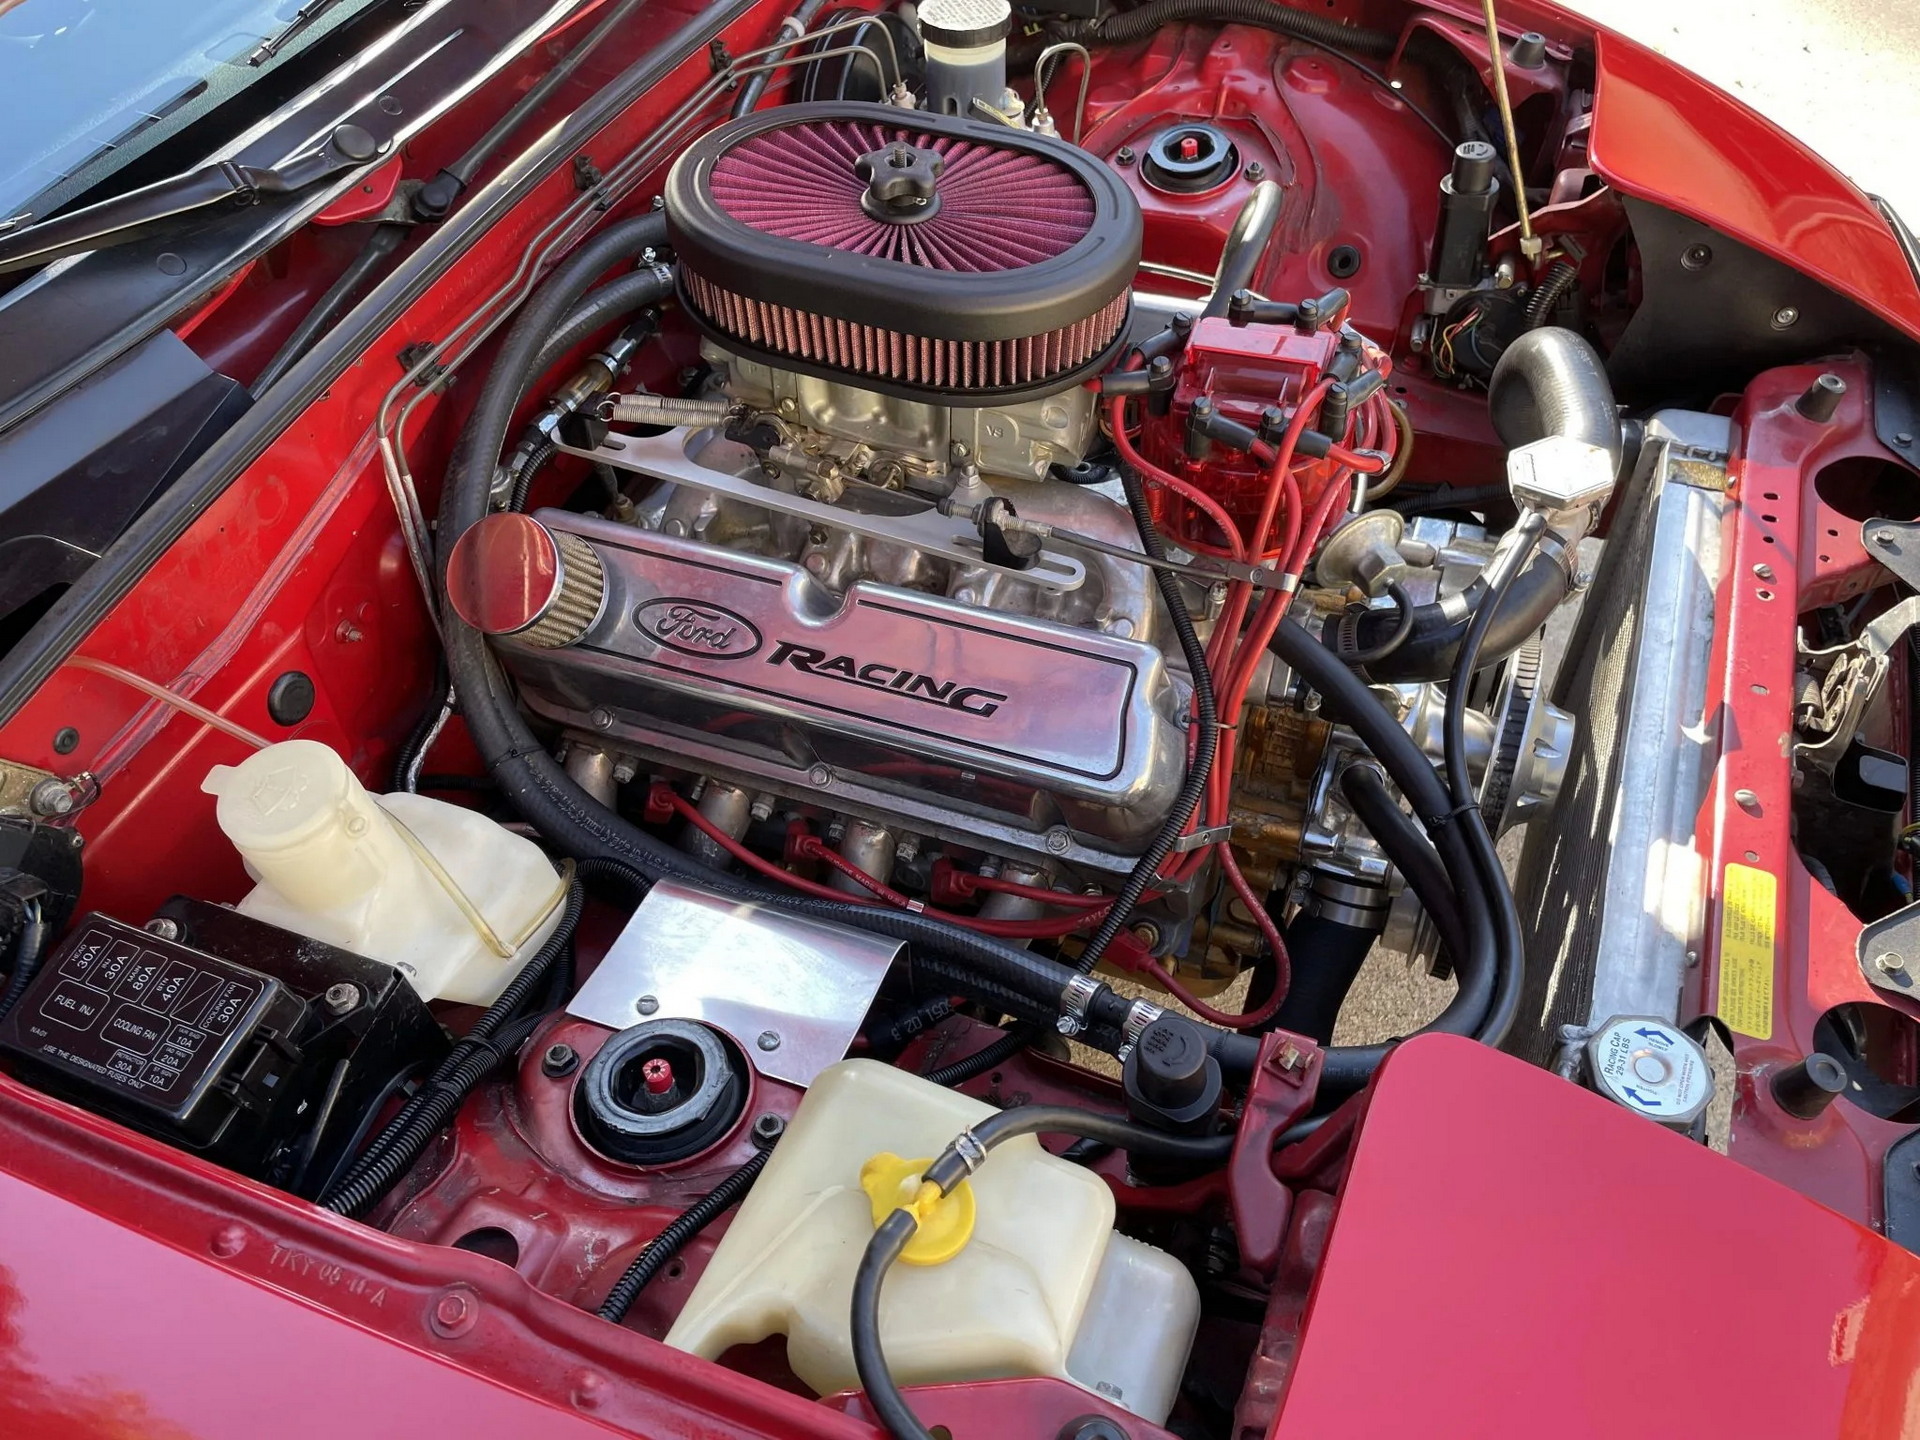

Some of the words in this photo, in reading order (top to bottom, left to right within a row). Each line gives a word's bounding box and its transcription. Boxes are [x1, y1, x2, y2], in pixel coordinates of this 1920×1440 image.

[655, 605, 737, 650] Ford
[765, 640, 1008, 718] RACING
[71, 944, 87, 962] HEAD
[77, 945, 101, 969] 30A
[101, 958, 111, 969] INJ
[104, 955, 128, 980] 30A
[127, 965, 142, 982] MAIN
[132, 965, 156, 990] 80A
[156, 977, 169, 991] BTN
[162, 976, 185, 1001] 40A
[54, 994, 76, 1010] FUEL
[78, 1004, 95, 1016] INJ
[202, 999, 226, 1028] COOLING
[224, 984, 237, 998] FAN
[218, 998, 242, 1023] 30A
[113, 1018, 143, 1036] COOLING
[142, 1029, 158, 1041] FAN
[1610, 1031, 1621, 1047] CAP
[176, 1036, 193, 1048] 10A
[1620, 1037, 1630, 1054] LBS
[43, 1044, 57, 1054] USE
[57, 1049, 71, 1060] THE
[69, 1054, 108, 1075] DESIGNATED
[107, 1070, 127, 1083] FUSES
[127, 1079, 146, 1090] ONLY
[114, 1061, 133, 1073] 30A
[116, 1051, 144, 1065] RETRACTOR
[161, 1054, 179, 1067] 20A
[1603, 1047, 1619, 1075] RACING
[1616, 1055, 1626, 1076] 29-31
[148, 1074, 165, 1086] 10A
